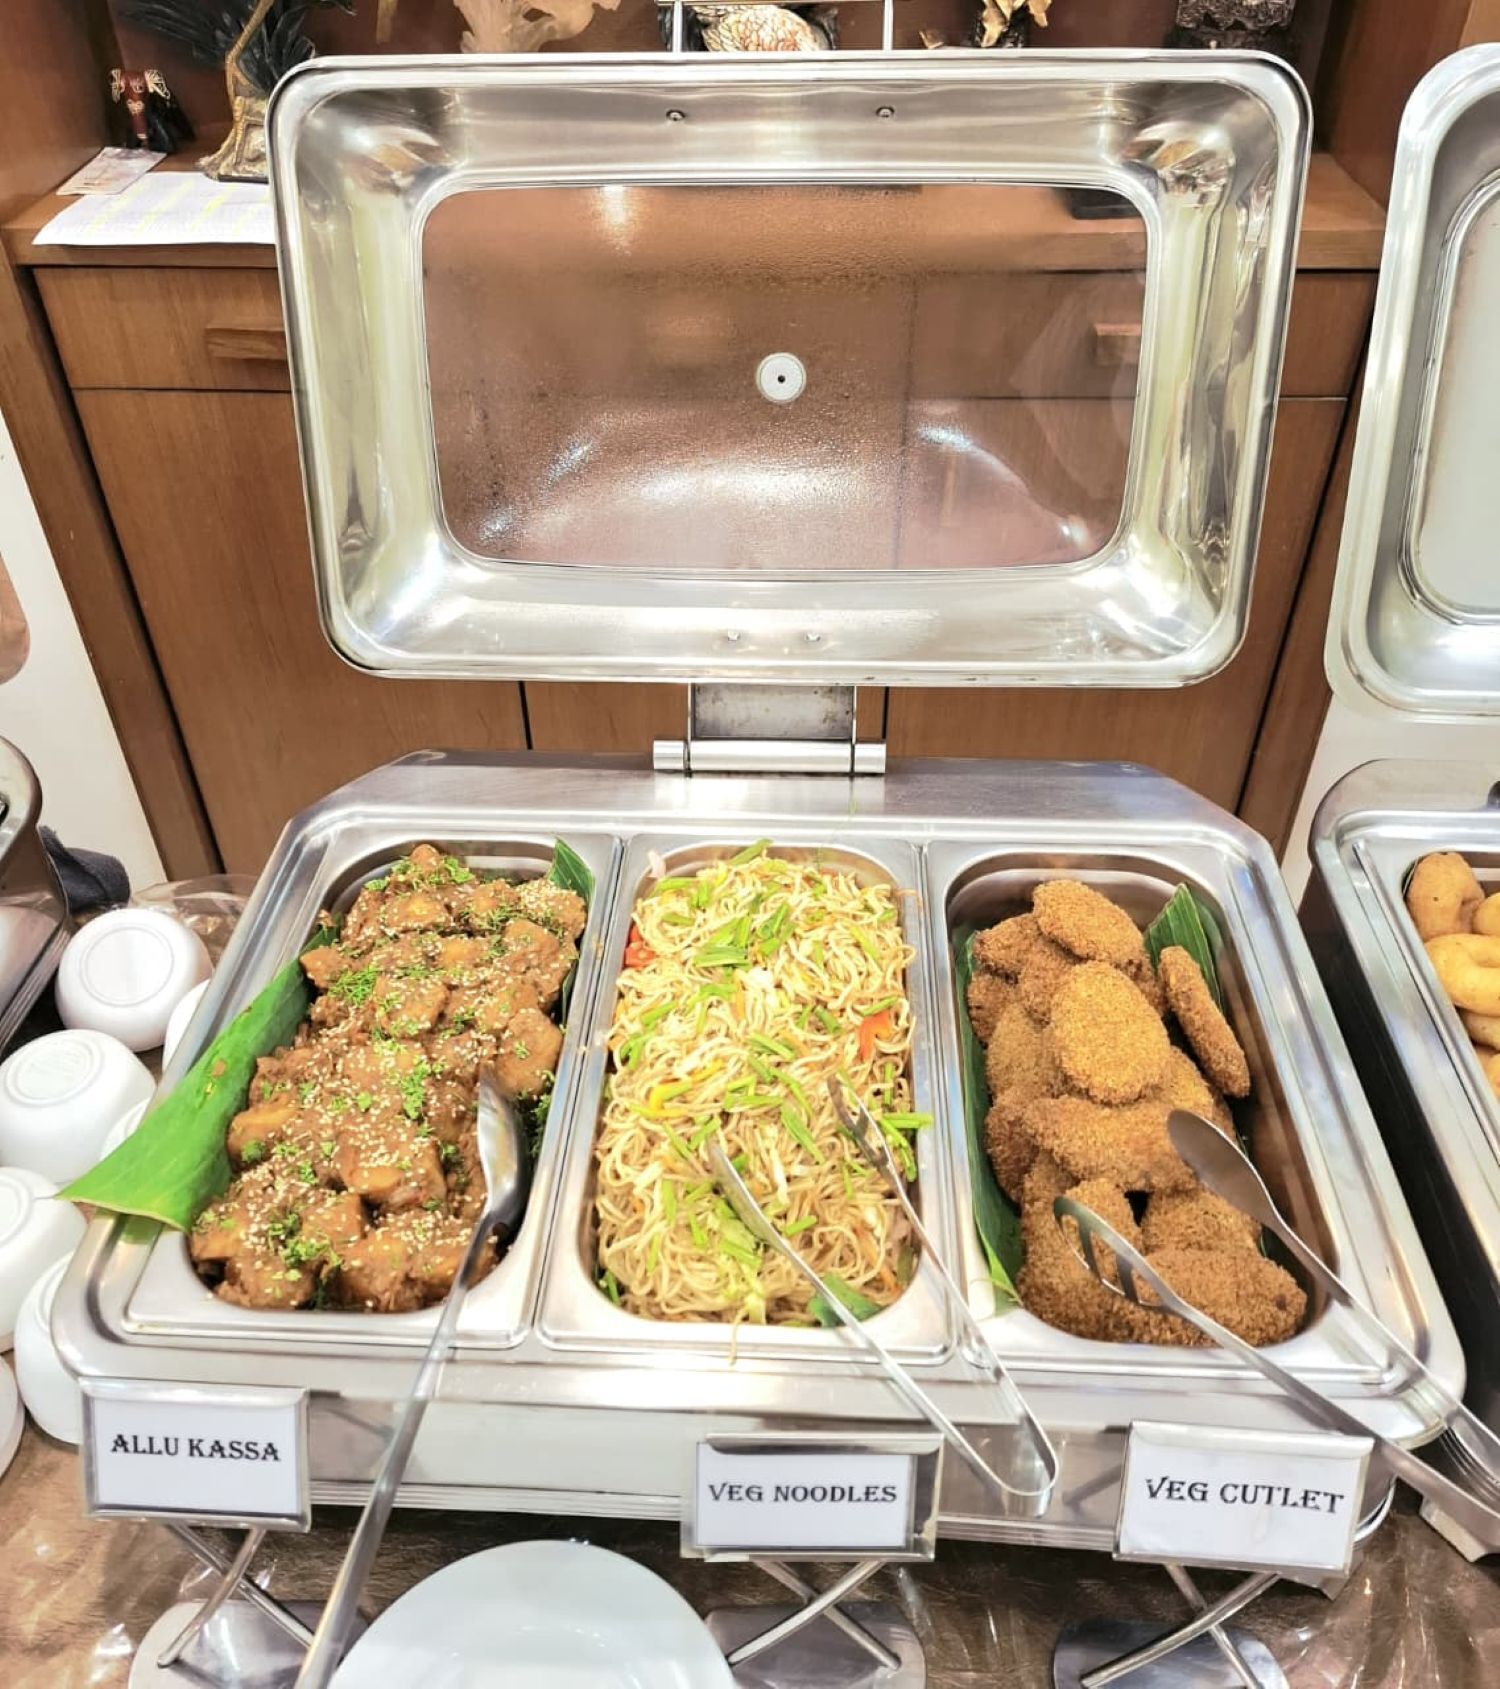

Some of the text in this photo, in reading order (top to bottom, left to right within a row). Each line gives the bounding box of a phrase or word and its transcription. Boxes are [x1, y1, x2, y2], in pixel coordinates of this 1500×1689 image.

[110, 1434, 280, 1461] ALLU KASSA
[709, 1483, 897, 1502] VEG NOODLES
[1145, 1476, 1344, 1513] VEG CUTLET
